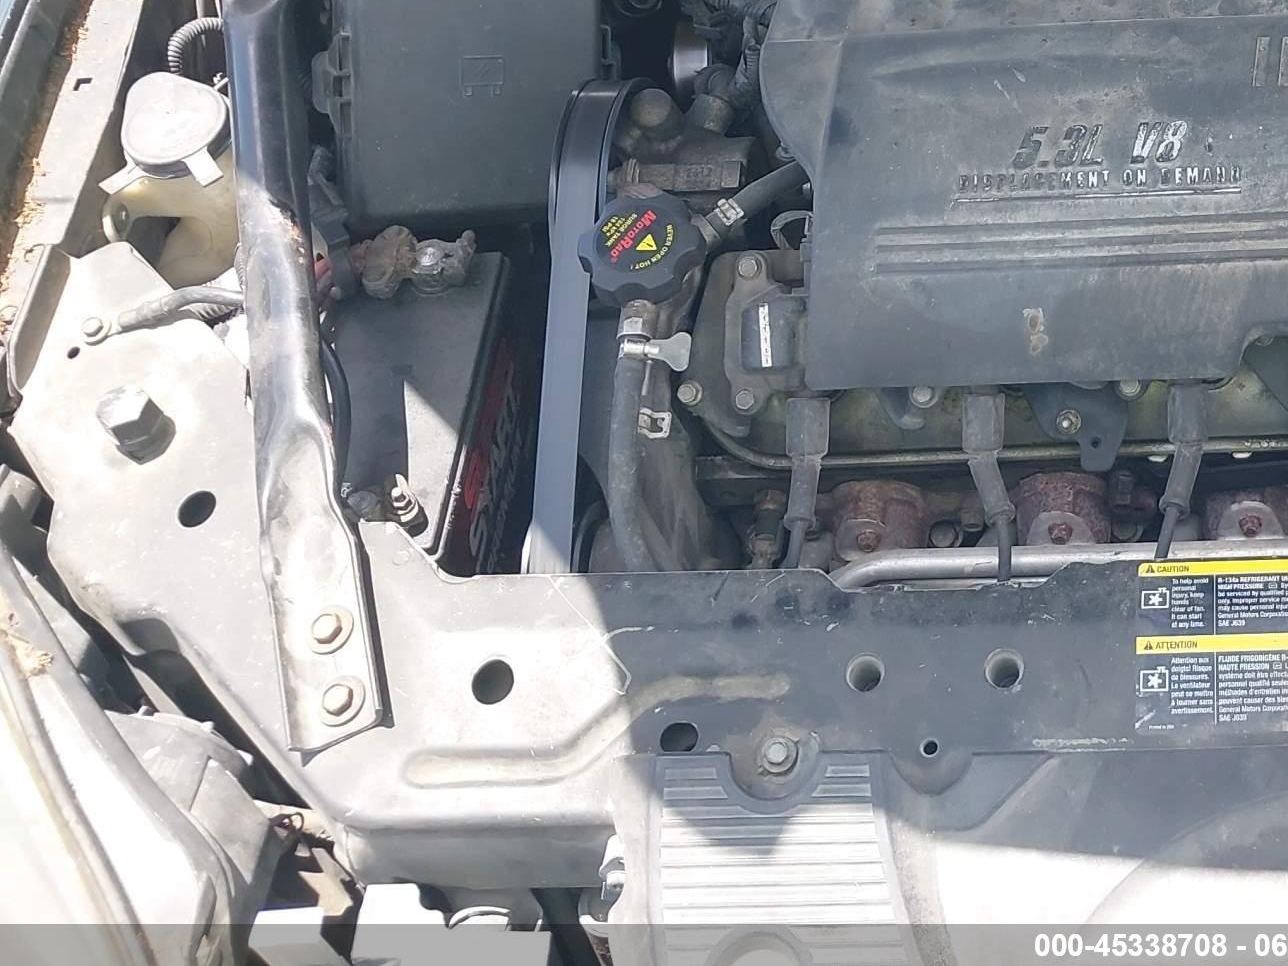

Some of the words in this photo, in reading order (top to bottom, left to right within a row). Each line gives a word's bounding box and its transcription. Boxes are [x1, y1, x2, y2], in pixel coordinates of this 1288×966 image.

[1011, 124, 1104, 168] 5.3L
[1131, 121, 1188, 164] V8
[1123, 168, 1146, 188] ON
[1160, 165, 1241, 186] DEMAND
[651, 246, 668, 262] OPEN
[1157, 565, 1189, 573] CAUTION
[1156, 641, 1197, 649] ATTENTION
